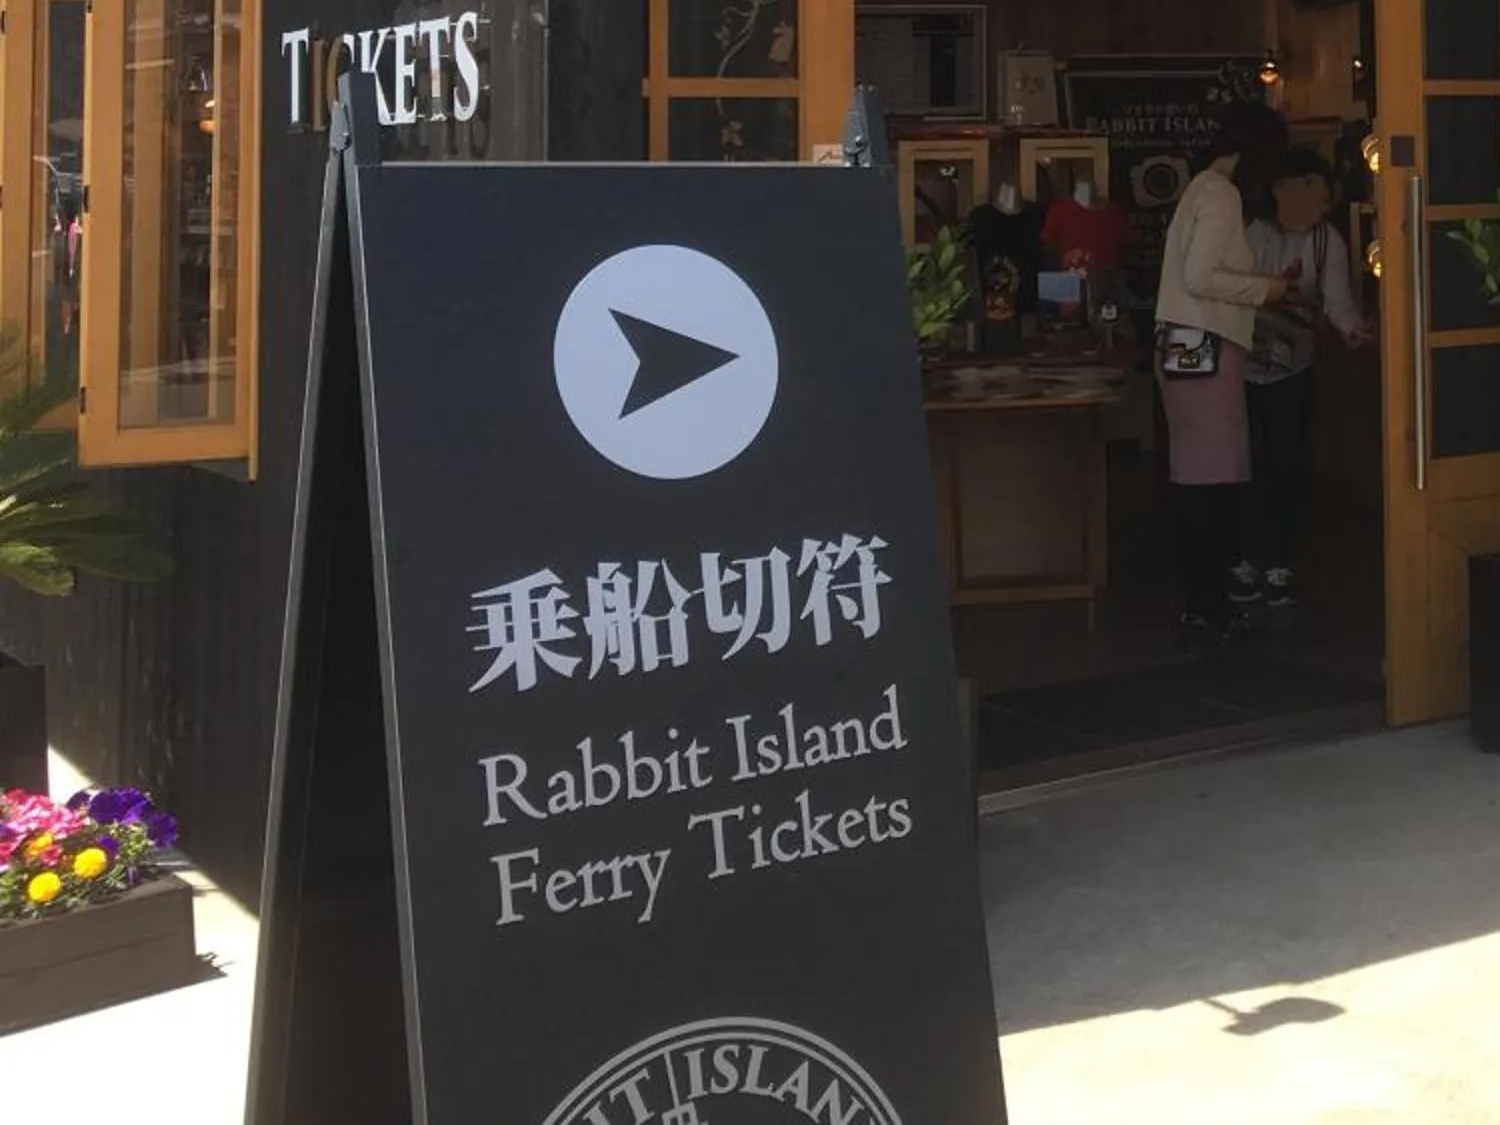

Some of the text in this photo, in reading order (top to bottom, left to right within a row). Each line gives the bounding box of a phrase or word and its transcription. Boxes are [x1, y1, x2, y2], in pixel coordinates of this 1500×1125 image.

[465, 532, 893, 694] 乗船切符
[477, 683, 908, 827] Rabbit Island
[489, 791, 913, 926] Ferry Tickets
[683, 1043, 880, 1125] ISLAN
